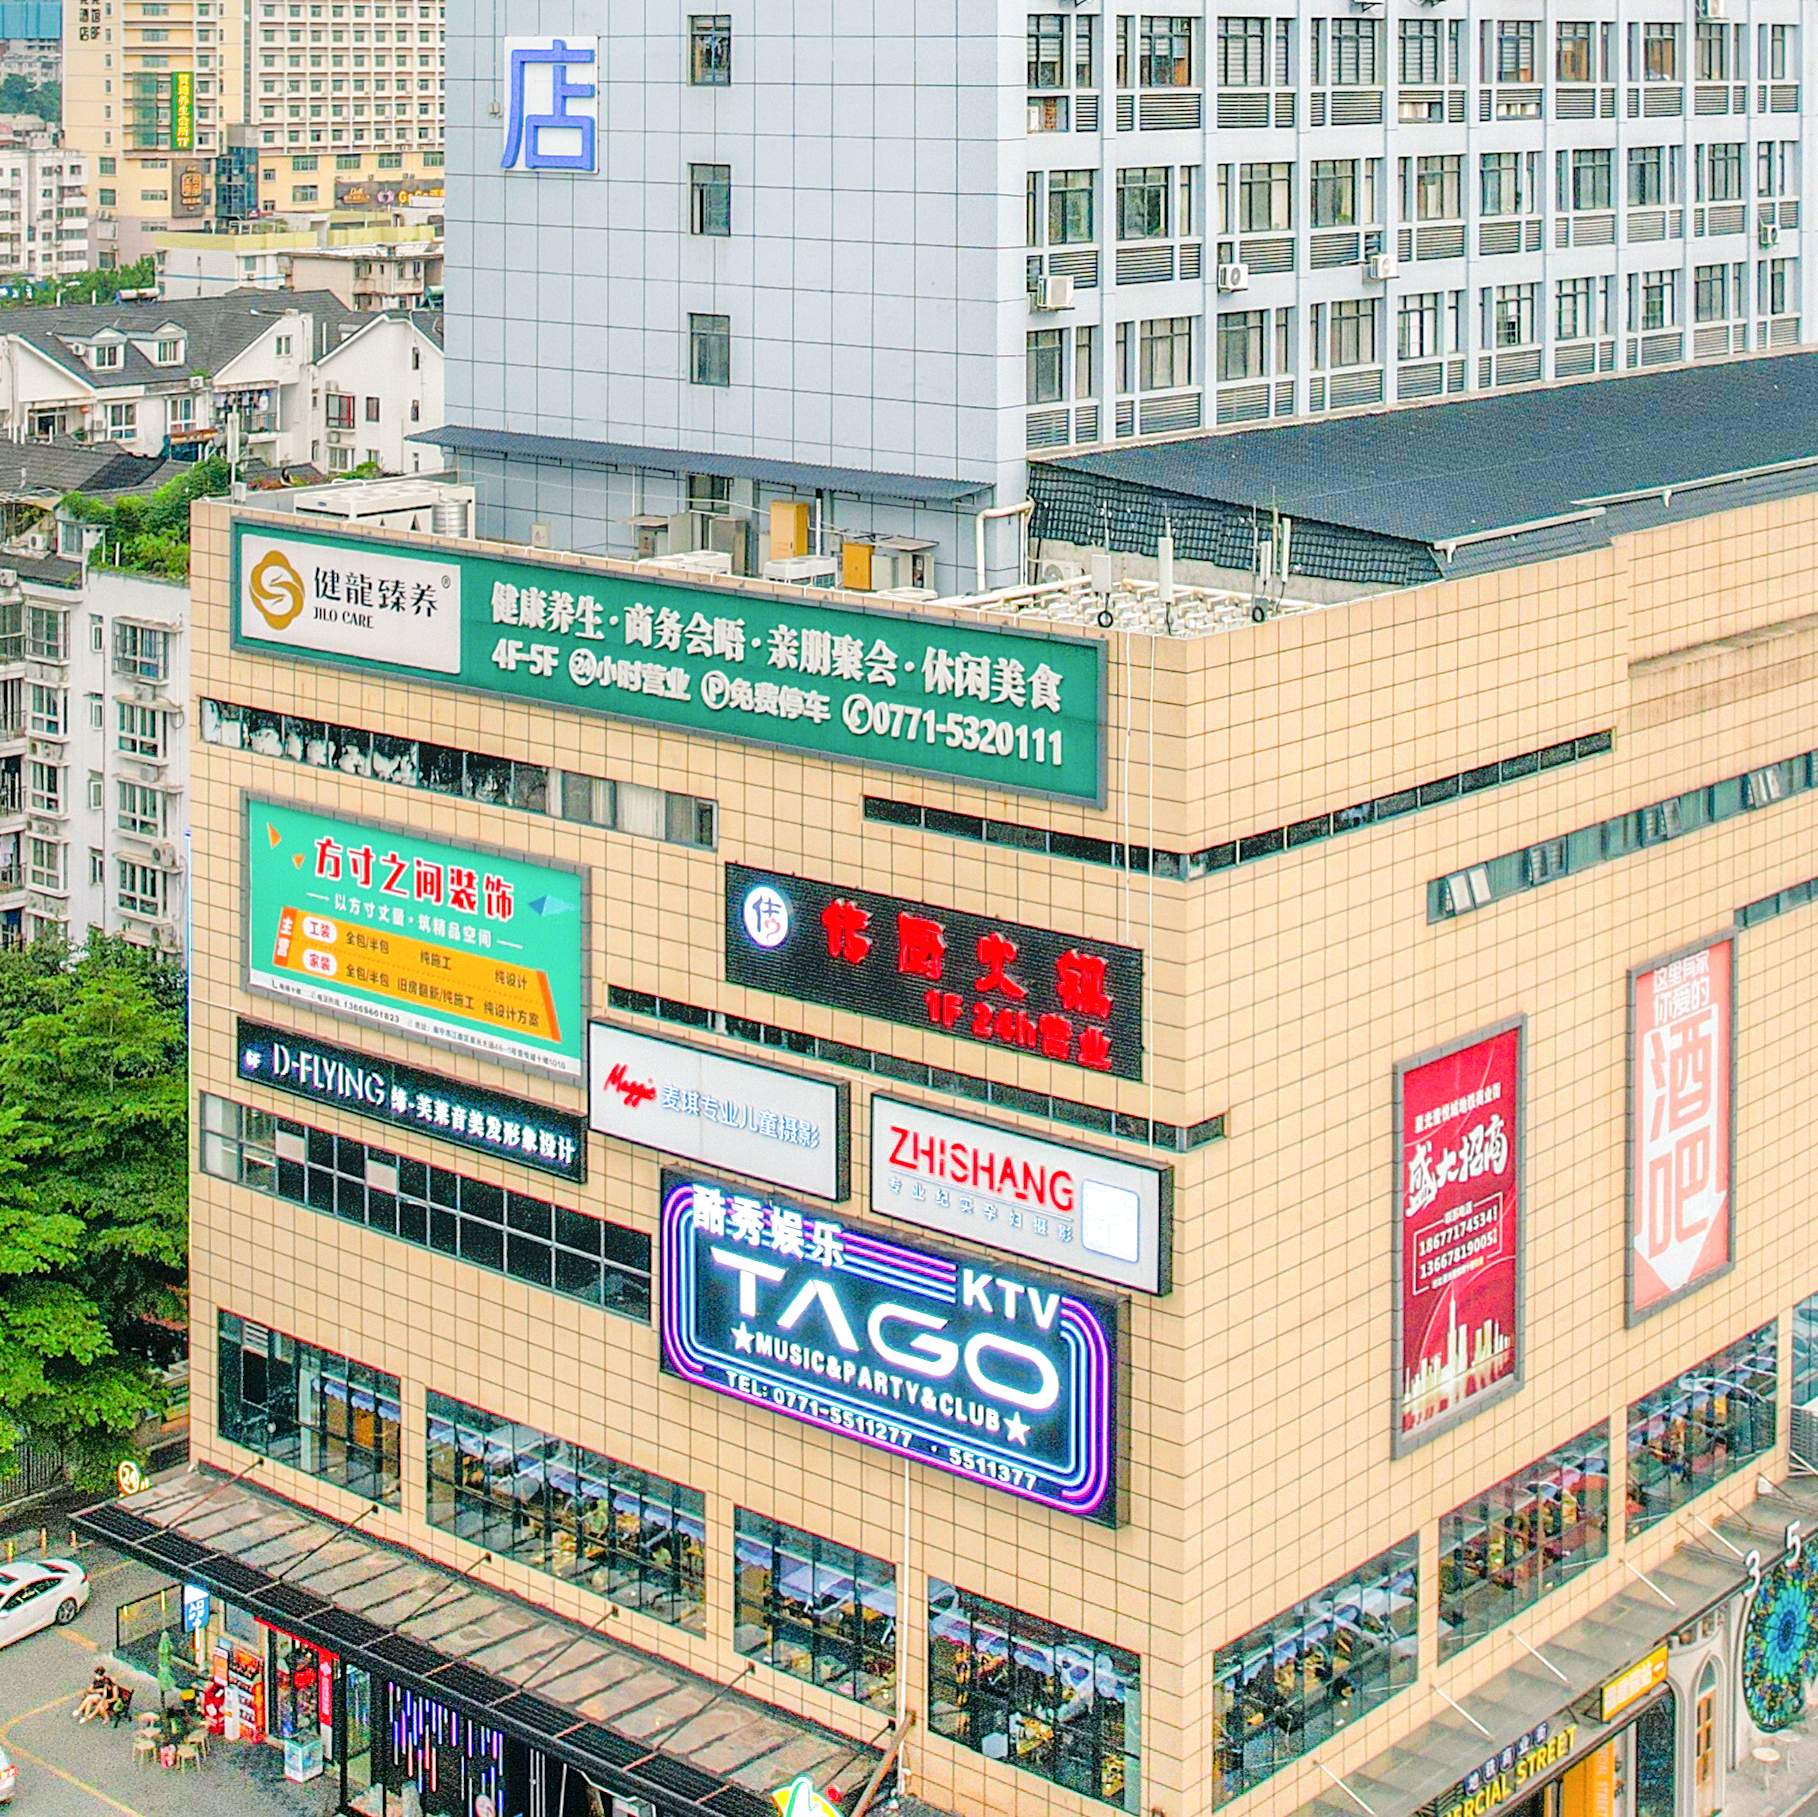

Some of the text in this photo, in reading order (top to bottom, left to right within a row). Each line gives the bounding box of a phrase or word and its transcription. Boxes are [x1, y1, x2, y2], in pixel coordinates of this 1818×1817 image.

[313, 567, 438, 618] 健龍臻养
[313, 606, 374, 630] JILO CARE
[491, 638, 559, 677] 4F-5F
[872, 700, 1063, 766] 0771-5320111
[314, 835, 515, 923] 方寸之间装饰
[276, 916, 293, 958] 主营
[309, 921, 528, 991] 工装 全包/半包 纯施工 纯设计
[309, 953, 331, 971] 家装
[345, 964, 390, 988] 全包/半包
[1654, 976, 1709, 1026] 你爱的
[923, 990, 963, 1027] 1F
[273, 1043, 384, 1107] D-FLYING
[661, 1084, 820, 1149] 麦琪专业儿童摄影
[1648, 1009, 1712, 1260] 酒吧
[888, 1125, 1074, 1211] ZHISHANG
[1405, 1113, 1508, 1217] 盛大招商
[692, 1184, 847, 1268] 酷秀娱乐
[1419, 1206, 1493, 1257] 18677174534
[1420, 1230, 1493, 1279] 13667819005
[710, 1246, 1060, 1410] TAGO
[962, 1269, 1061, 1329] KTV
[773, 1387, 912, 1448] 0771-5511277
[1516, 1723, 1577, 1787] STREET
